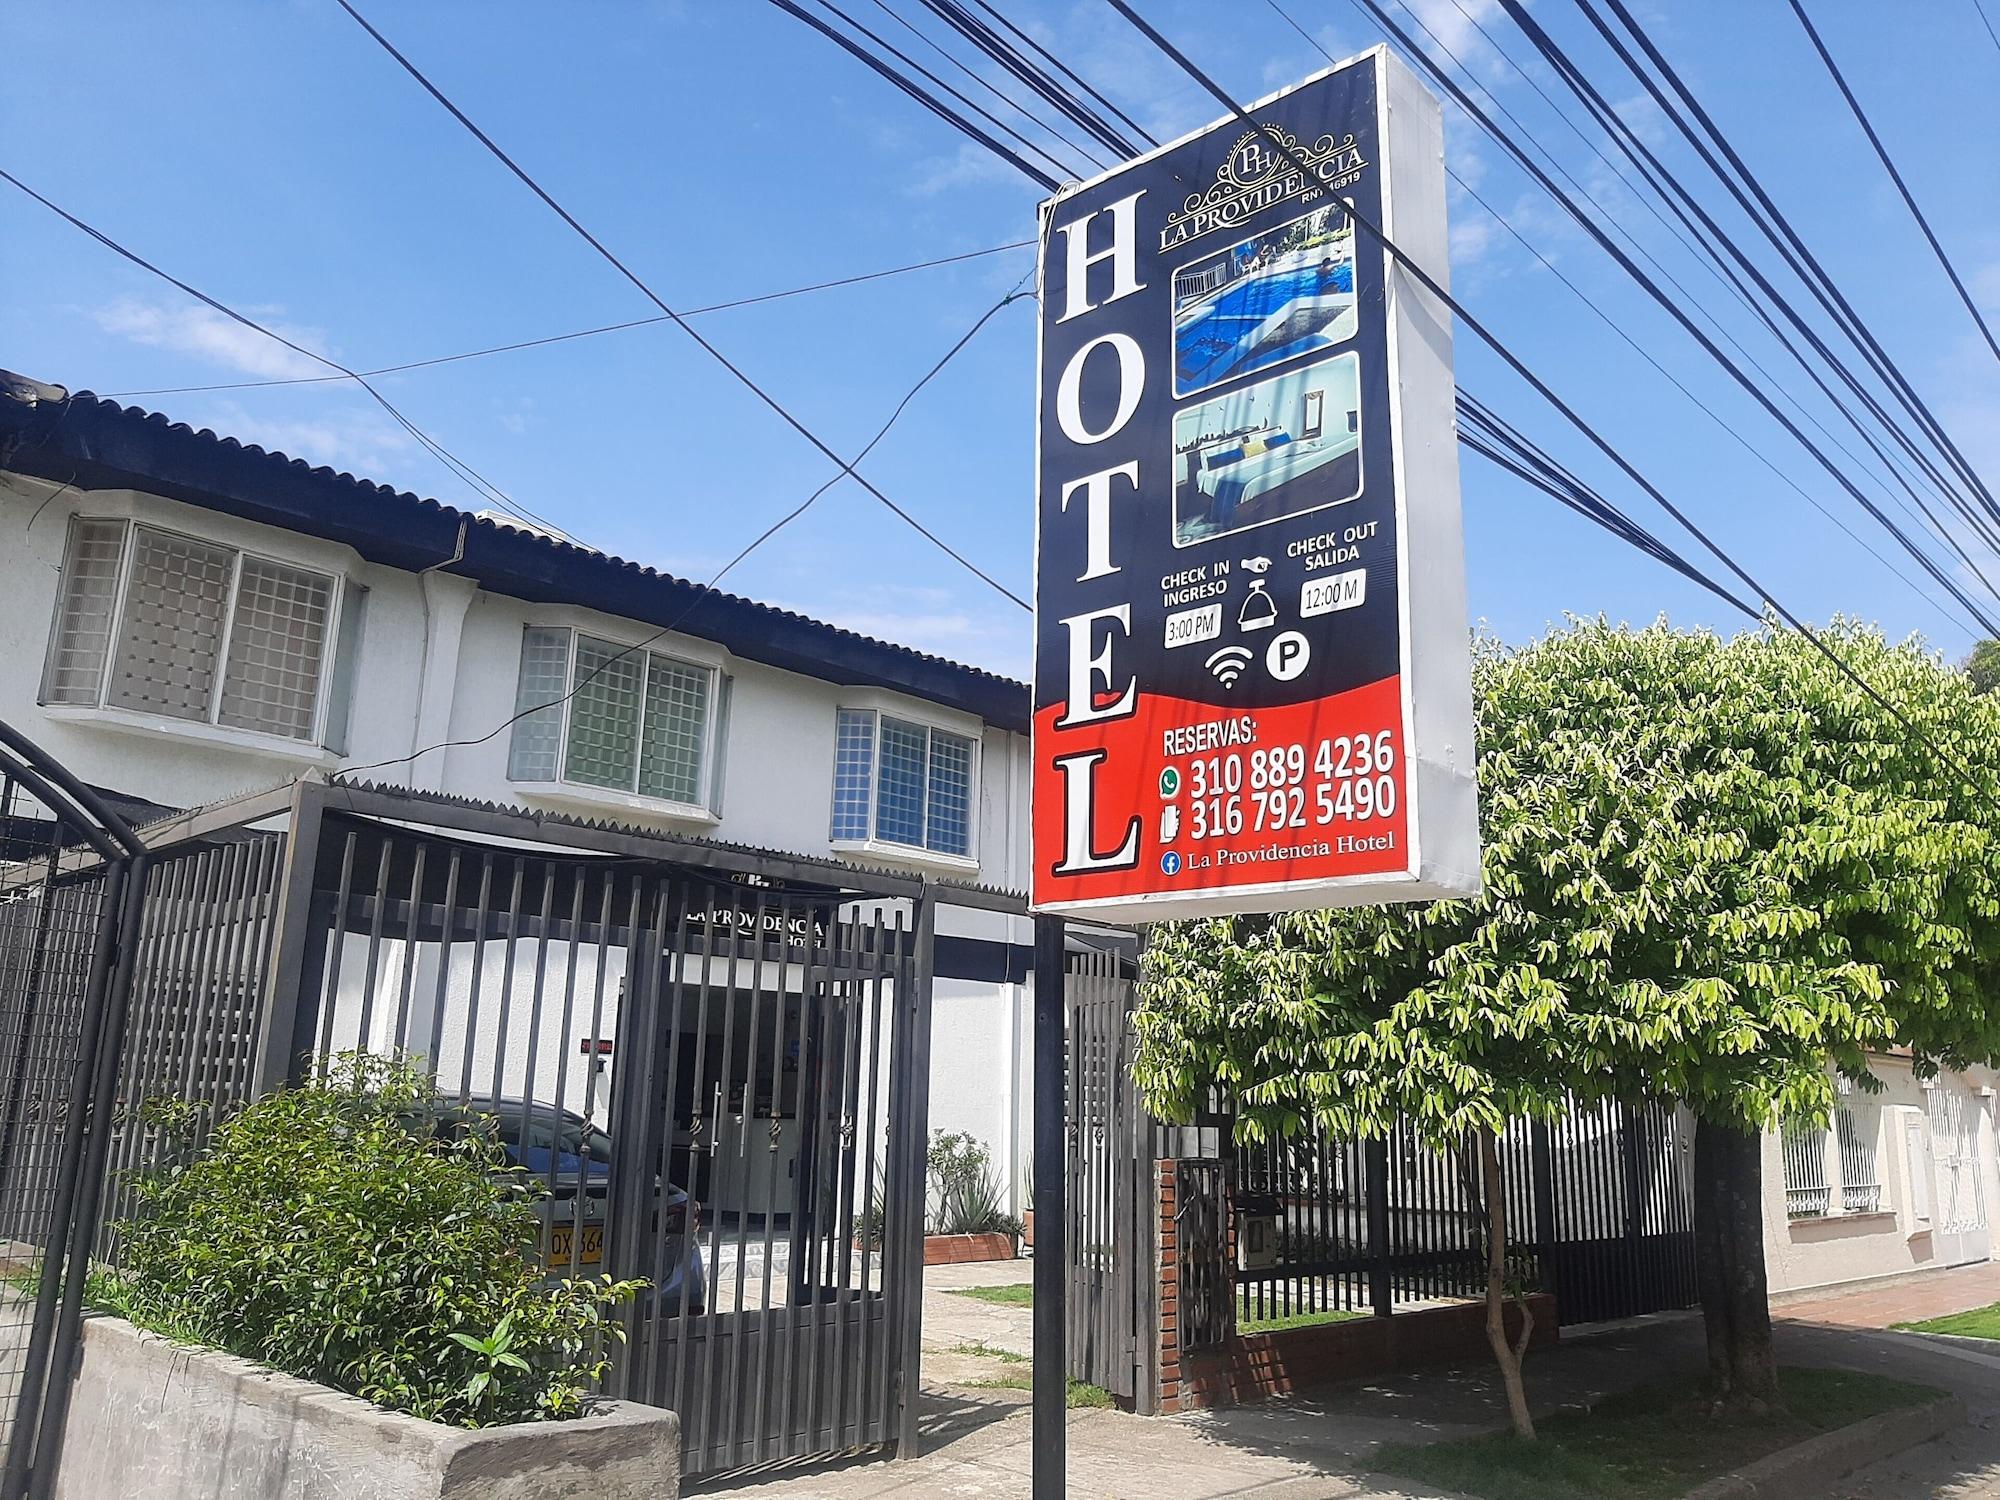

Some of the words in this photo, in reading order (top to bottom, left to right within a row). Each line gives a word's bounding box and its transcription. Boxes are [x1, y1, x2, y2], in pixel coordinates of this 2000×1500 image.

[1159, 224, 1189, 250] LA
[1052, 189, 1148, 877] HOTEL
[1287, 532, 1336, 557] CHECK
[1343, 521, 1378, 542] OUT
[1305, 545, 1360, 571] SALIDA
[1161, 567, 1206, 590] CHECK
[1213, 560, 1230, 577] IN
[1163, 580, 1228, 607] INGRESO
[1306, 584, 1341, 609] 12:00
[1345, 579, 1358, 601] M
[1169, 618, 1193, 641] 3:00
[1196, 613, 1214, 636] PM
[1279, 640, 1300, 672] P
[1163, 716, 1258, 757] RESERVAS:
[1190, 754, 1243, 799] 310
[1250, 744, 1305, 790] 889
[1314, 730, 1394, 779] 4236
[1190, 795, 1243, 839] 316
[1251, 787, 1306, 832] 792
[1316, 775, 1396, 824] 5490
[1188, 853, 1211, 870] La
[1216, 839, 1330, 866] Providencia
[1336, 832, 1394, 854] Hotel
[712, 909, 824, 936] PROVDENCA
